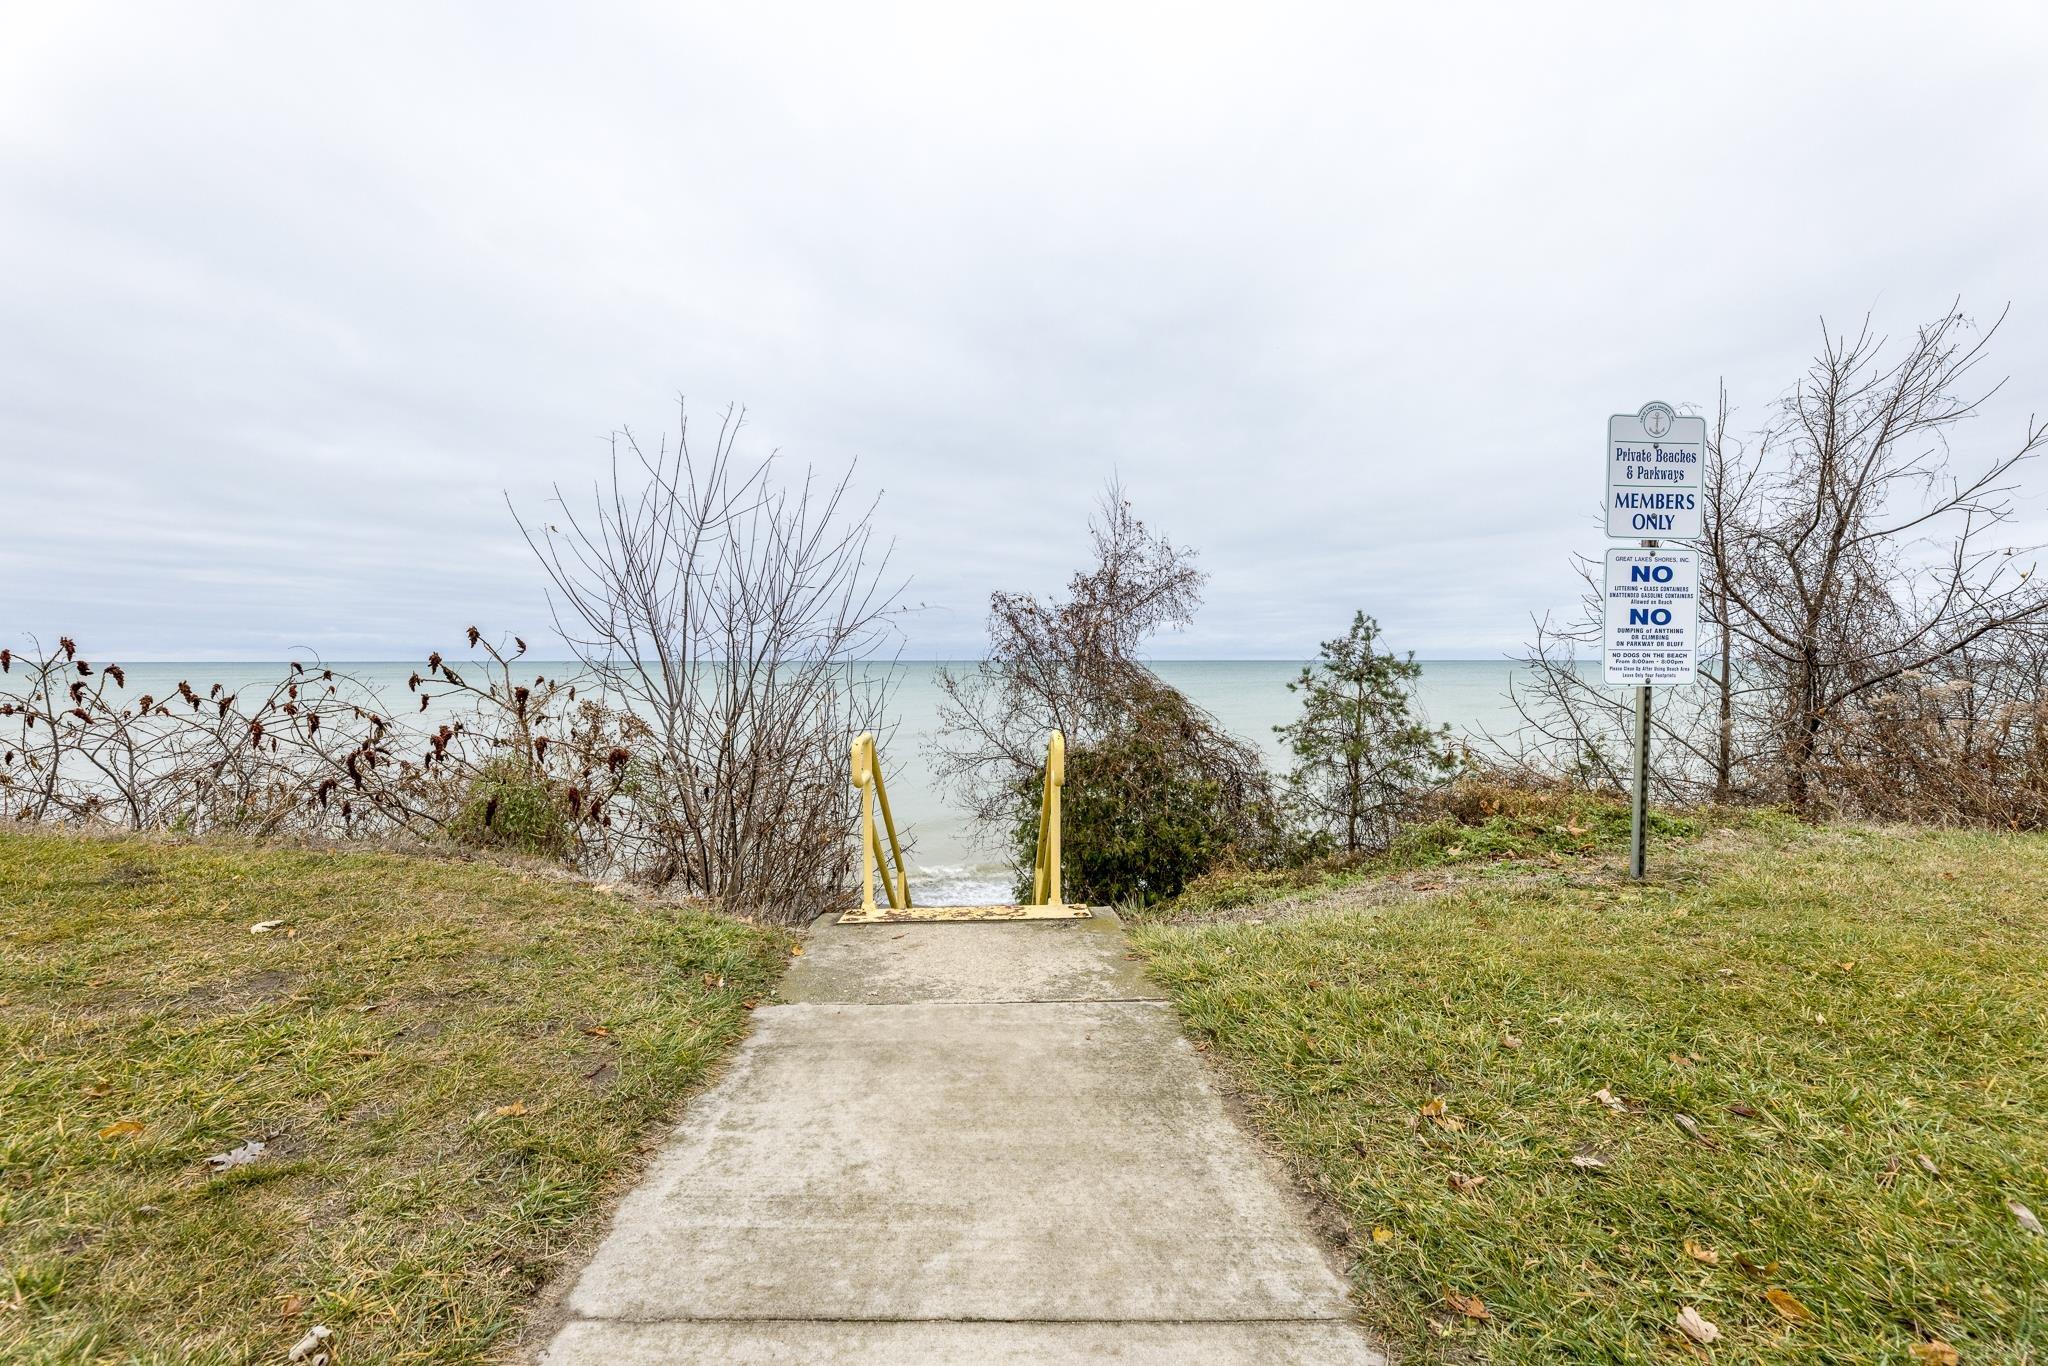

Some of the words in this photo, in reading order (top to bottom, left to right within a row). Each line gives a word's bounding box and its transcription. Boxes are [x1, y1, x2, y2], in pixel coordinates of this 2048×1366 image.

[1616, 447, 1652, 462] Private
[1656, 448, 1697, 463] Beaches
[1626, 465, 1633, 479] &
[1637, 466, 1685, 483] Parkways
[1614, 492, 1695, 510] MEMBERS
[1632, 513, 1675, 530] ONLY
[1631, 565, 1674, 583] NO
[1629, 608, 1672, 626] NO
